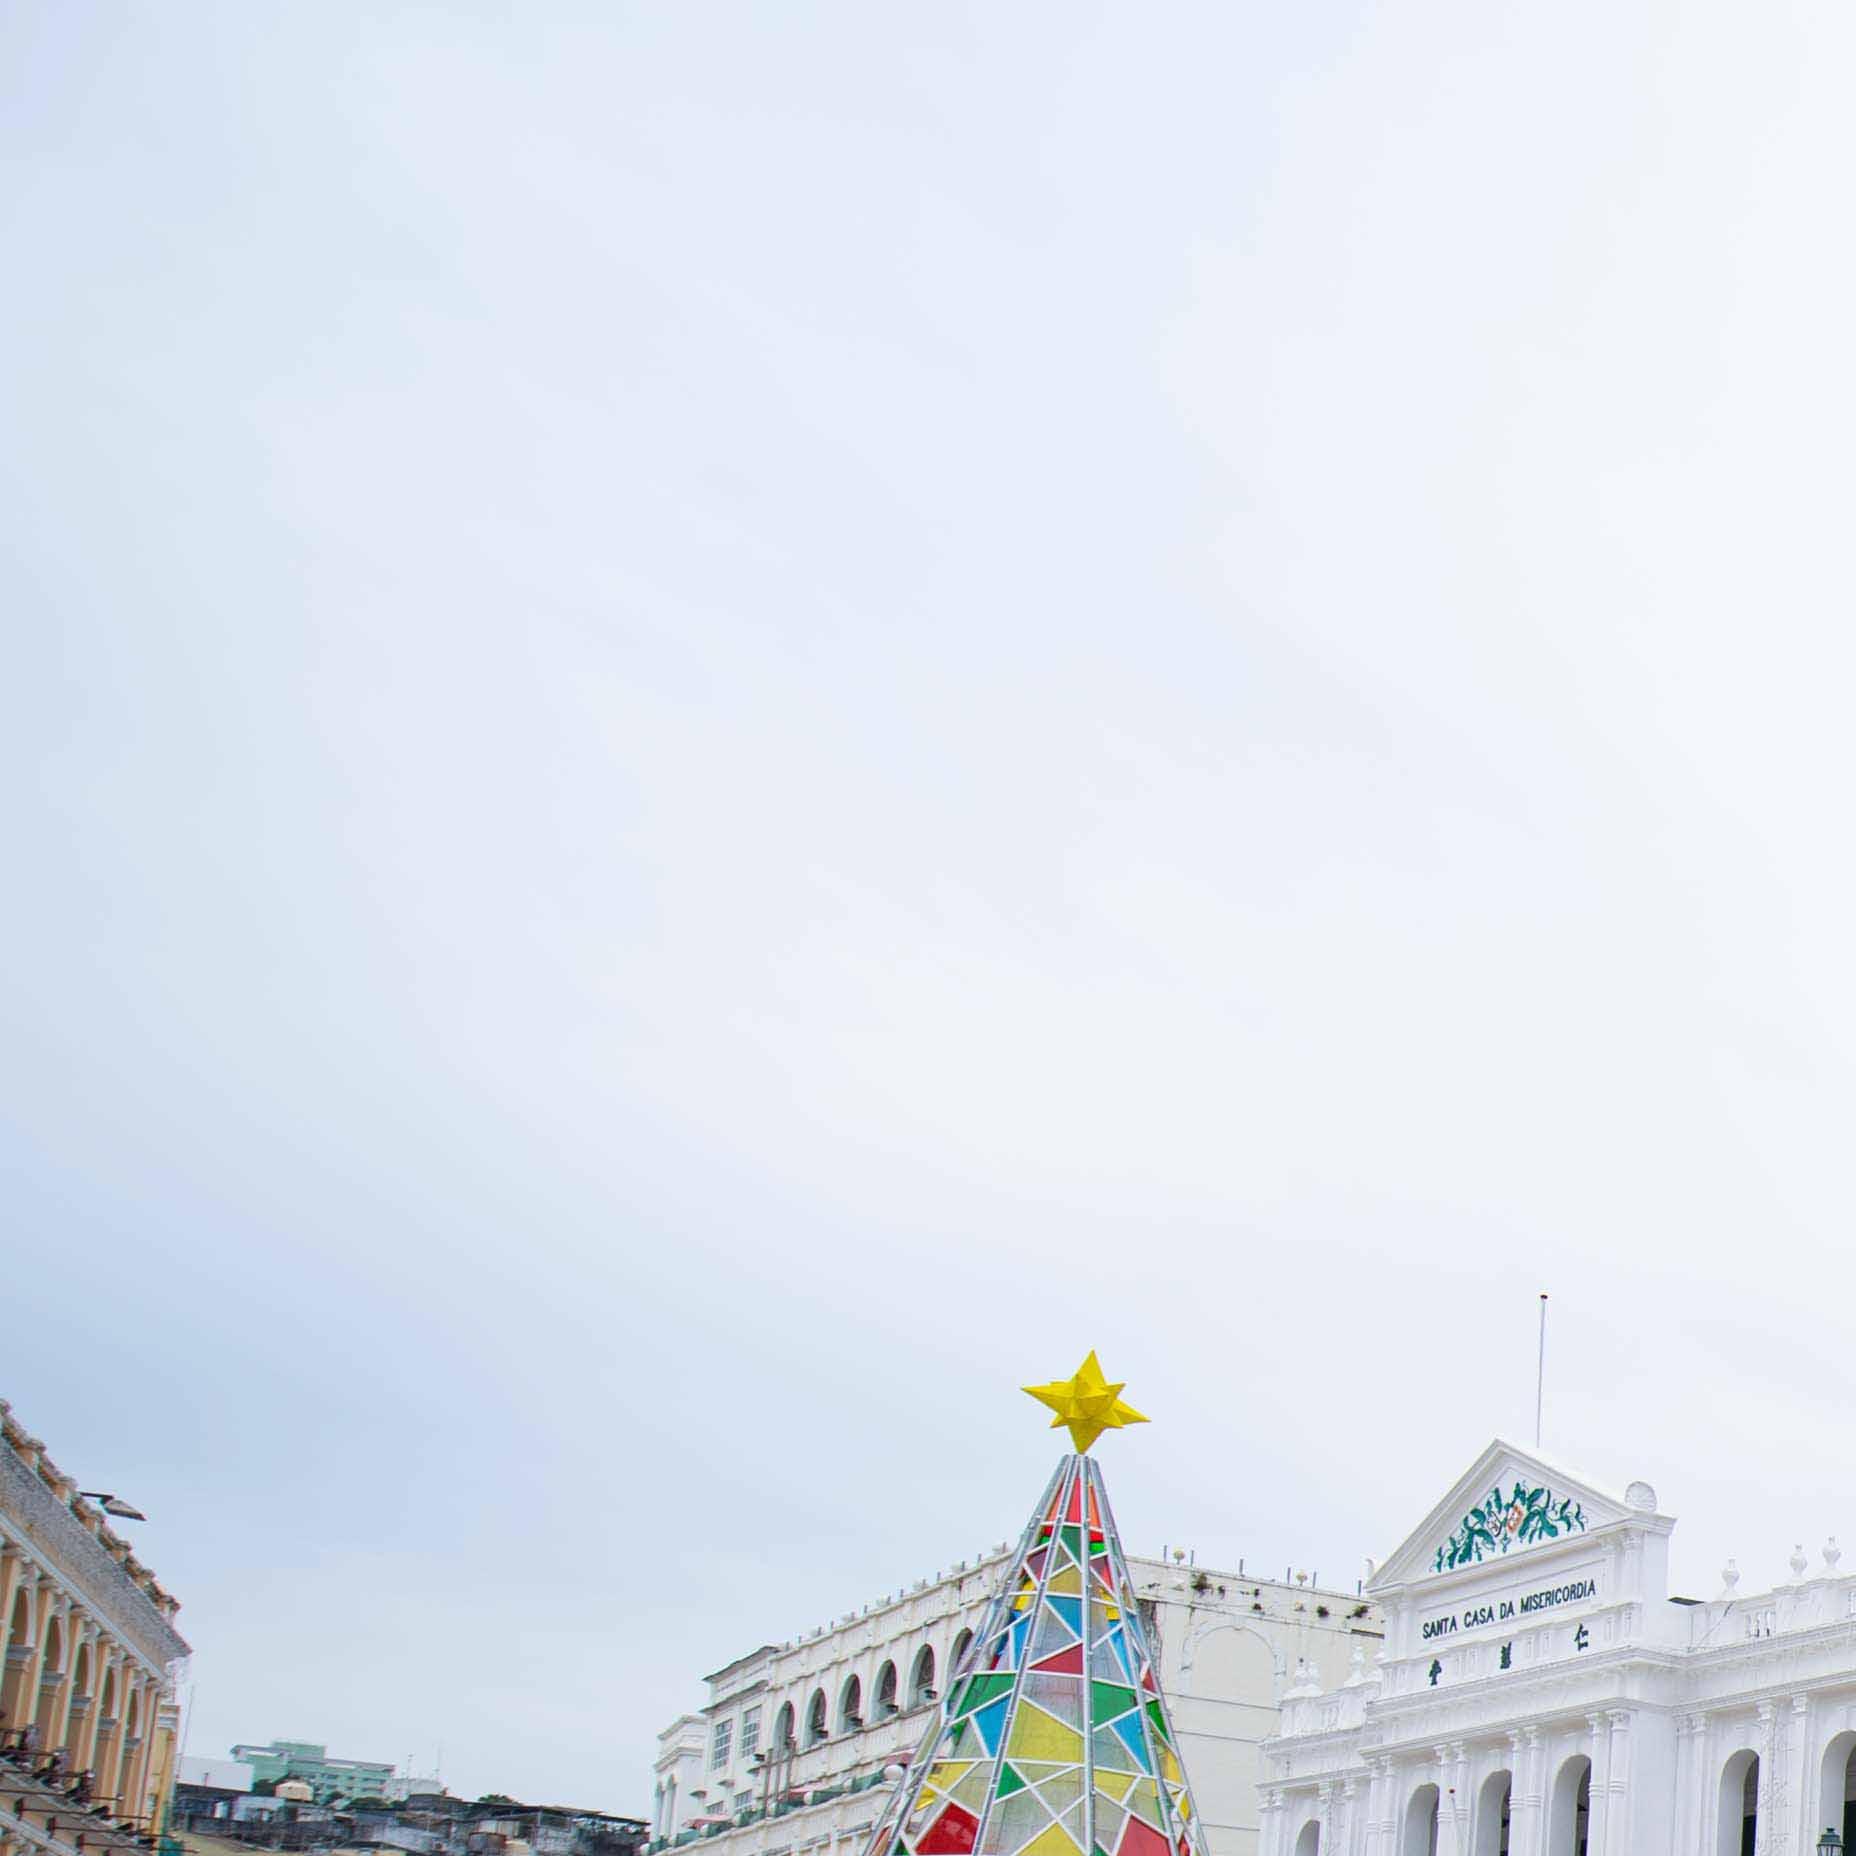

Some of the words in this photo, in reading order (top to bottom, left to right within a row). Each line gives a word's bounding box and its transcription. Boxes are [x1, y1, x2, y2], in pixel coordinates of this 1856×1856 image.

[1423, 1615, 1457, 1639] SANTA
[1464, 1607, 1494, 1628] CASA
[1500, 1601, 1515, 1620] DA
[1520, 1579, 1596, 1613] MISERICORDIA
